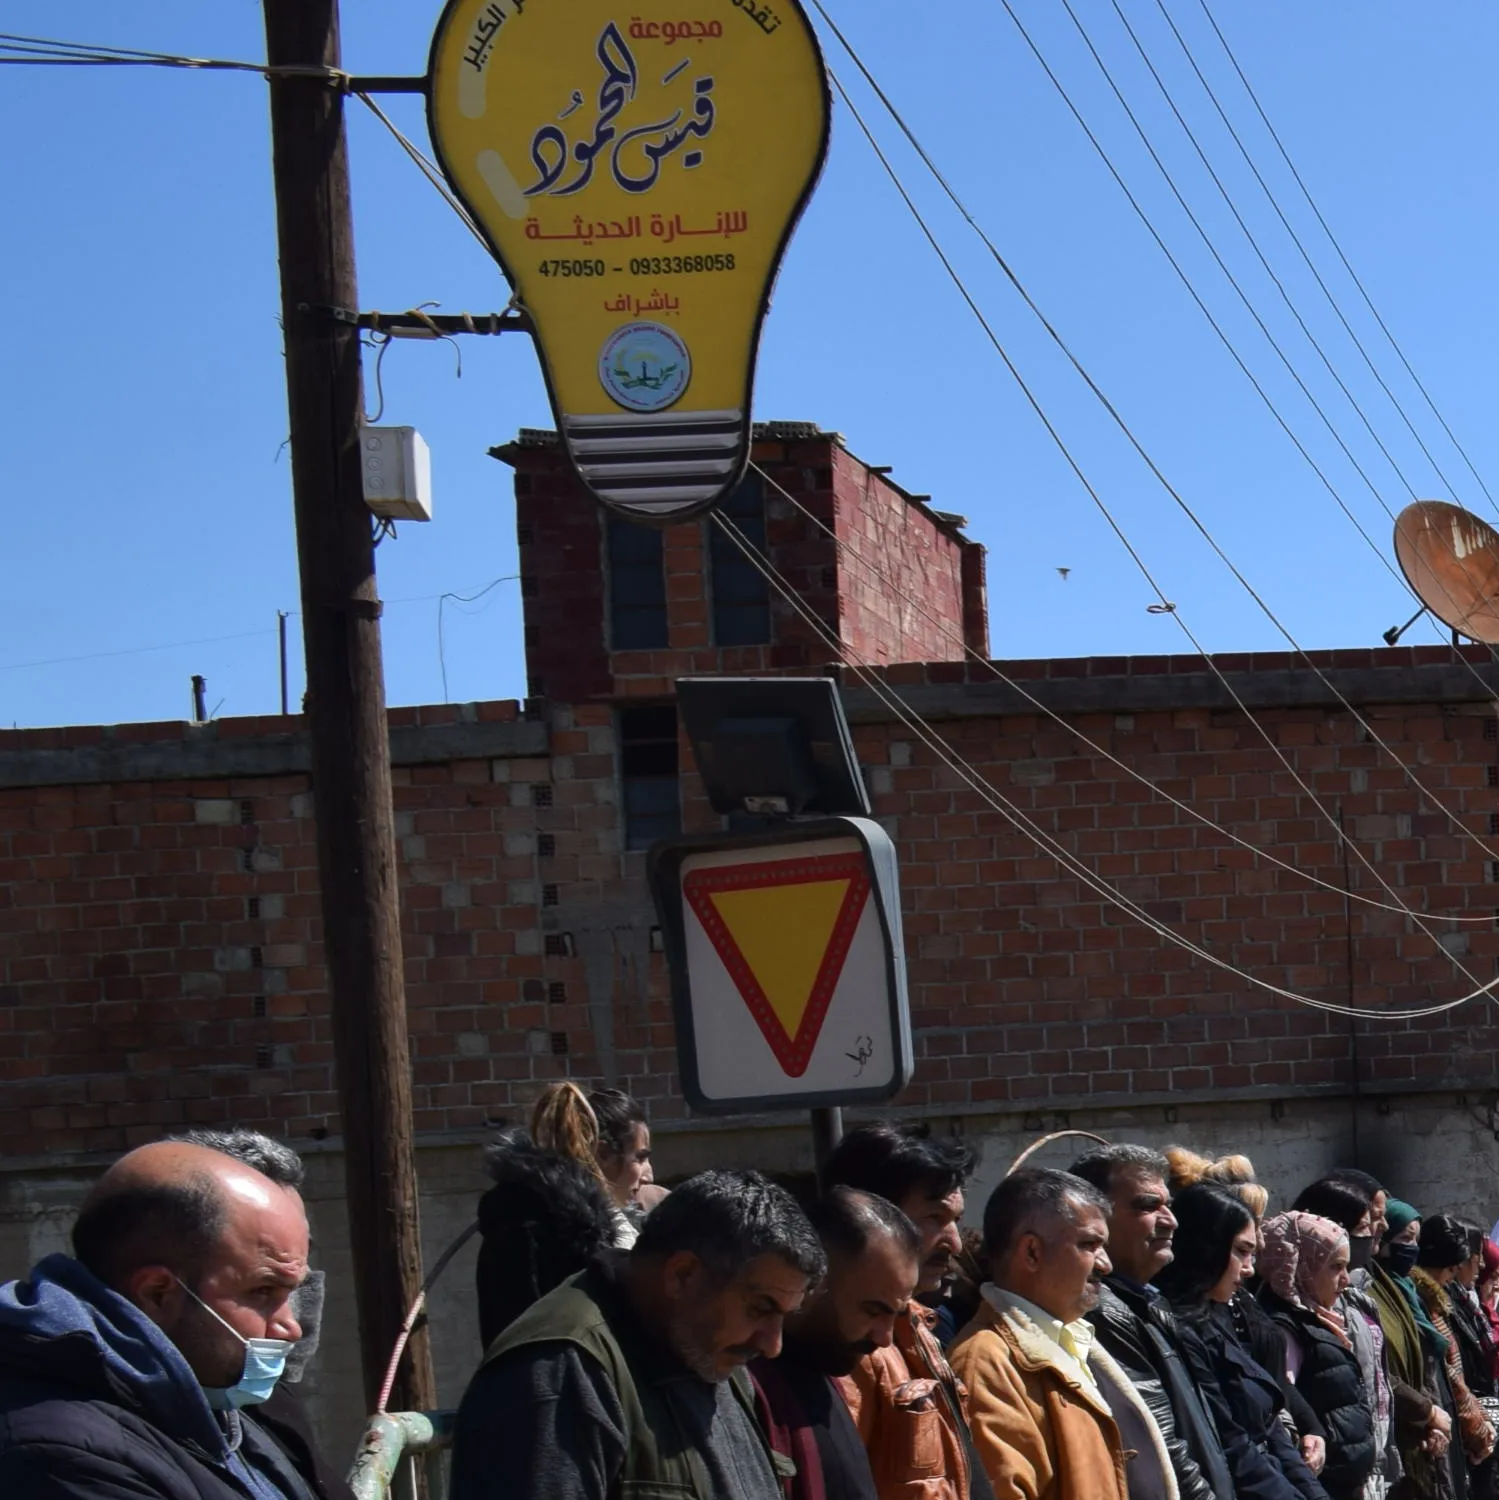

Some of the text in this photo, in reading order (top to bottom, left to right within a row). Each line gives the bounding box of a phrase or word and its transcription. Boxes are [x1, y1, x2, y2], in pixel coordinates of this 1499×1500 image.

[629, 16, 723, 46] مجموعة
[539, 259, 605, 278] 475050
[630, 253, 736, 276] 0933368058
[604, 288, 680, 317] بإشراف
